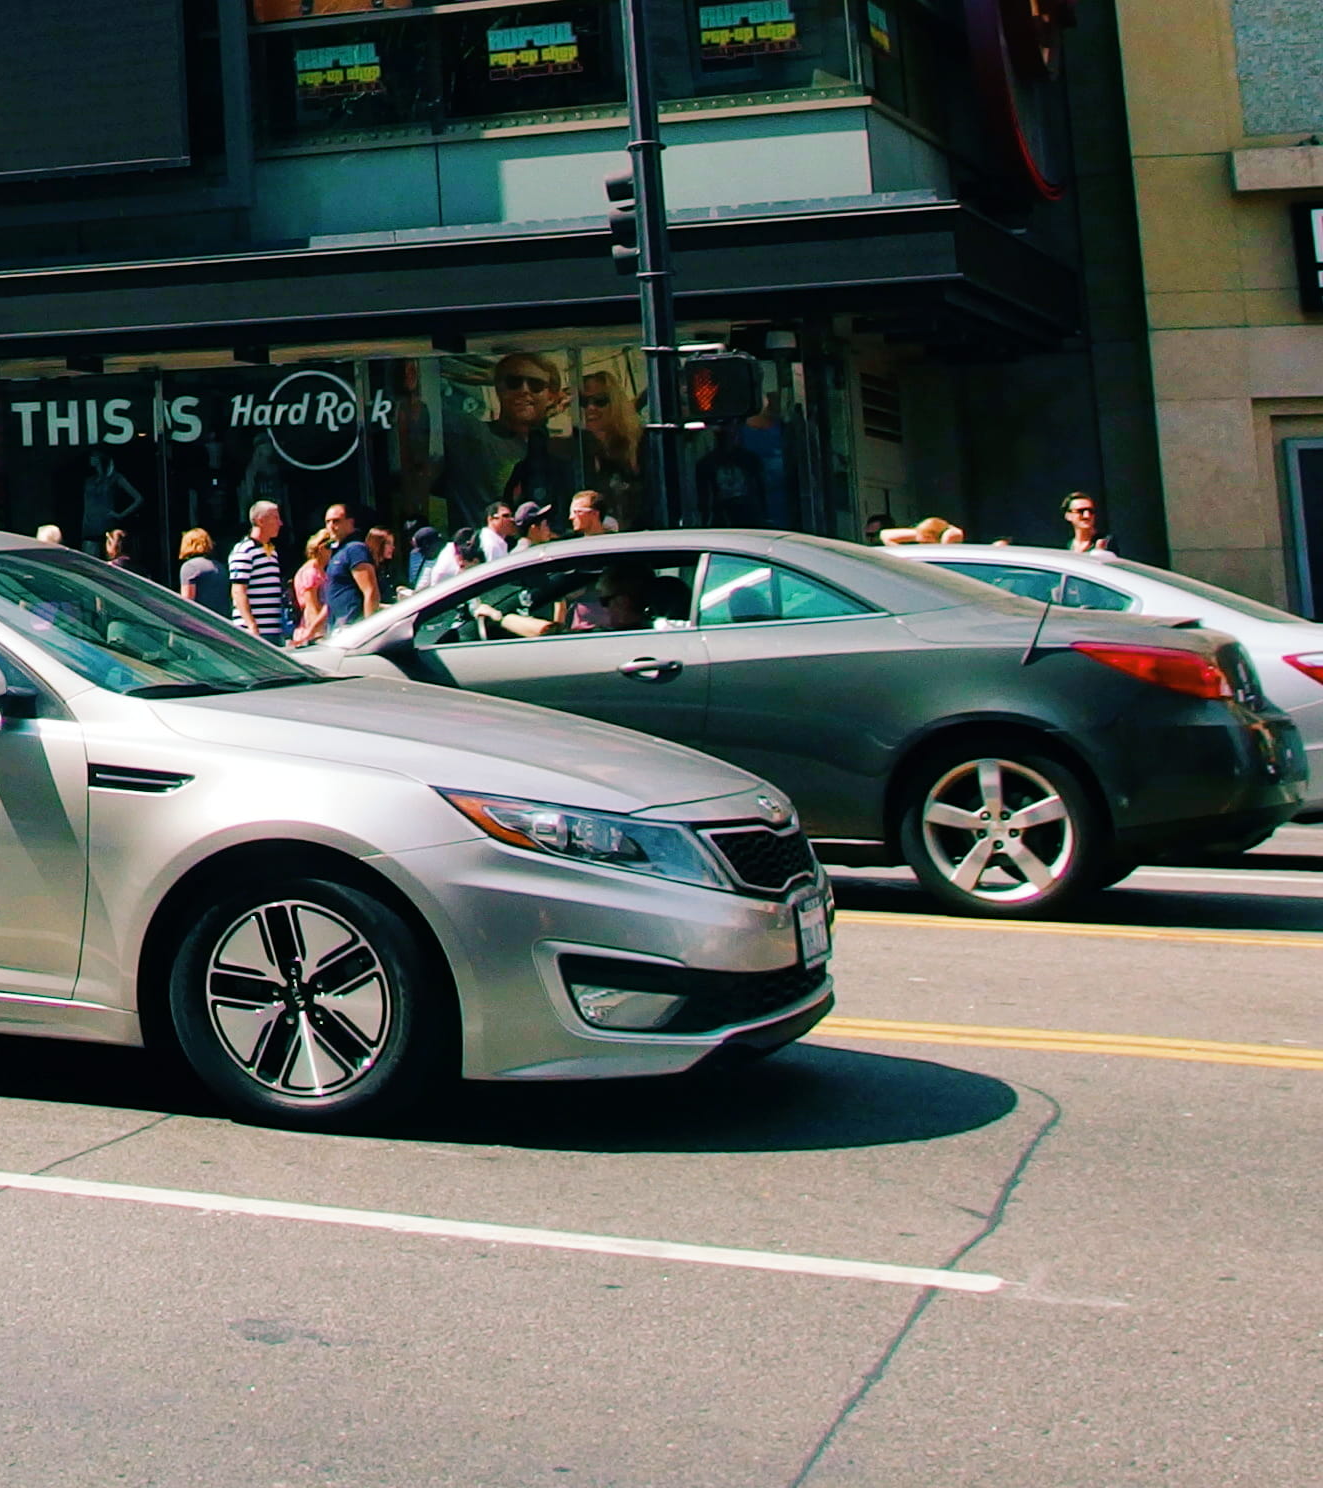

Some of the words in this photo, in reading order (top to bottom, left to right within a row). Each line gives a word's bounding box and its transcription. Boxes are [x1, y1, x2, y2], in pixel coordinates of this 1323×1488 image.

[11, 398, 135, 447] THIS
[230, 392, 310, 428] Hard
[314, 388, 394, 433] Rok
